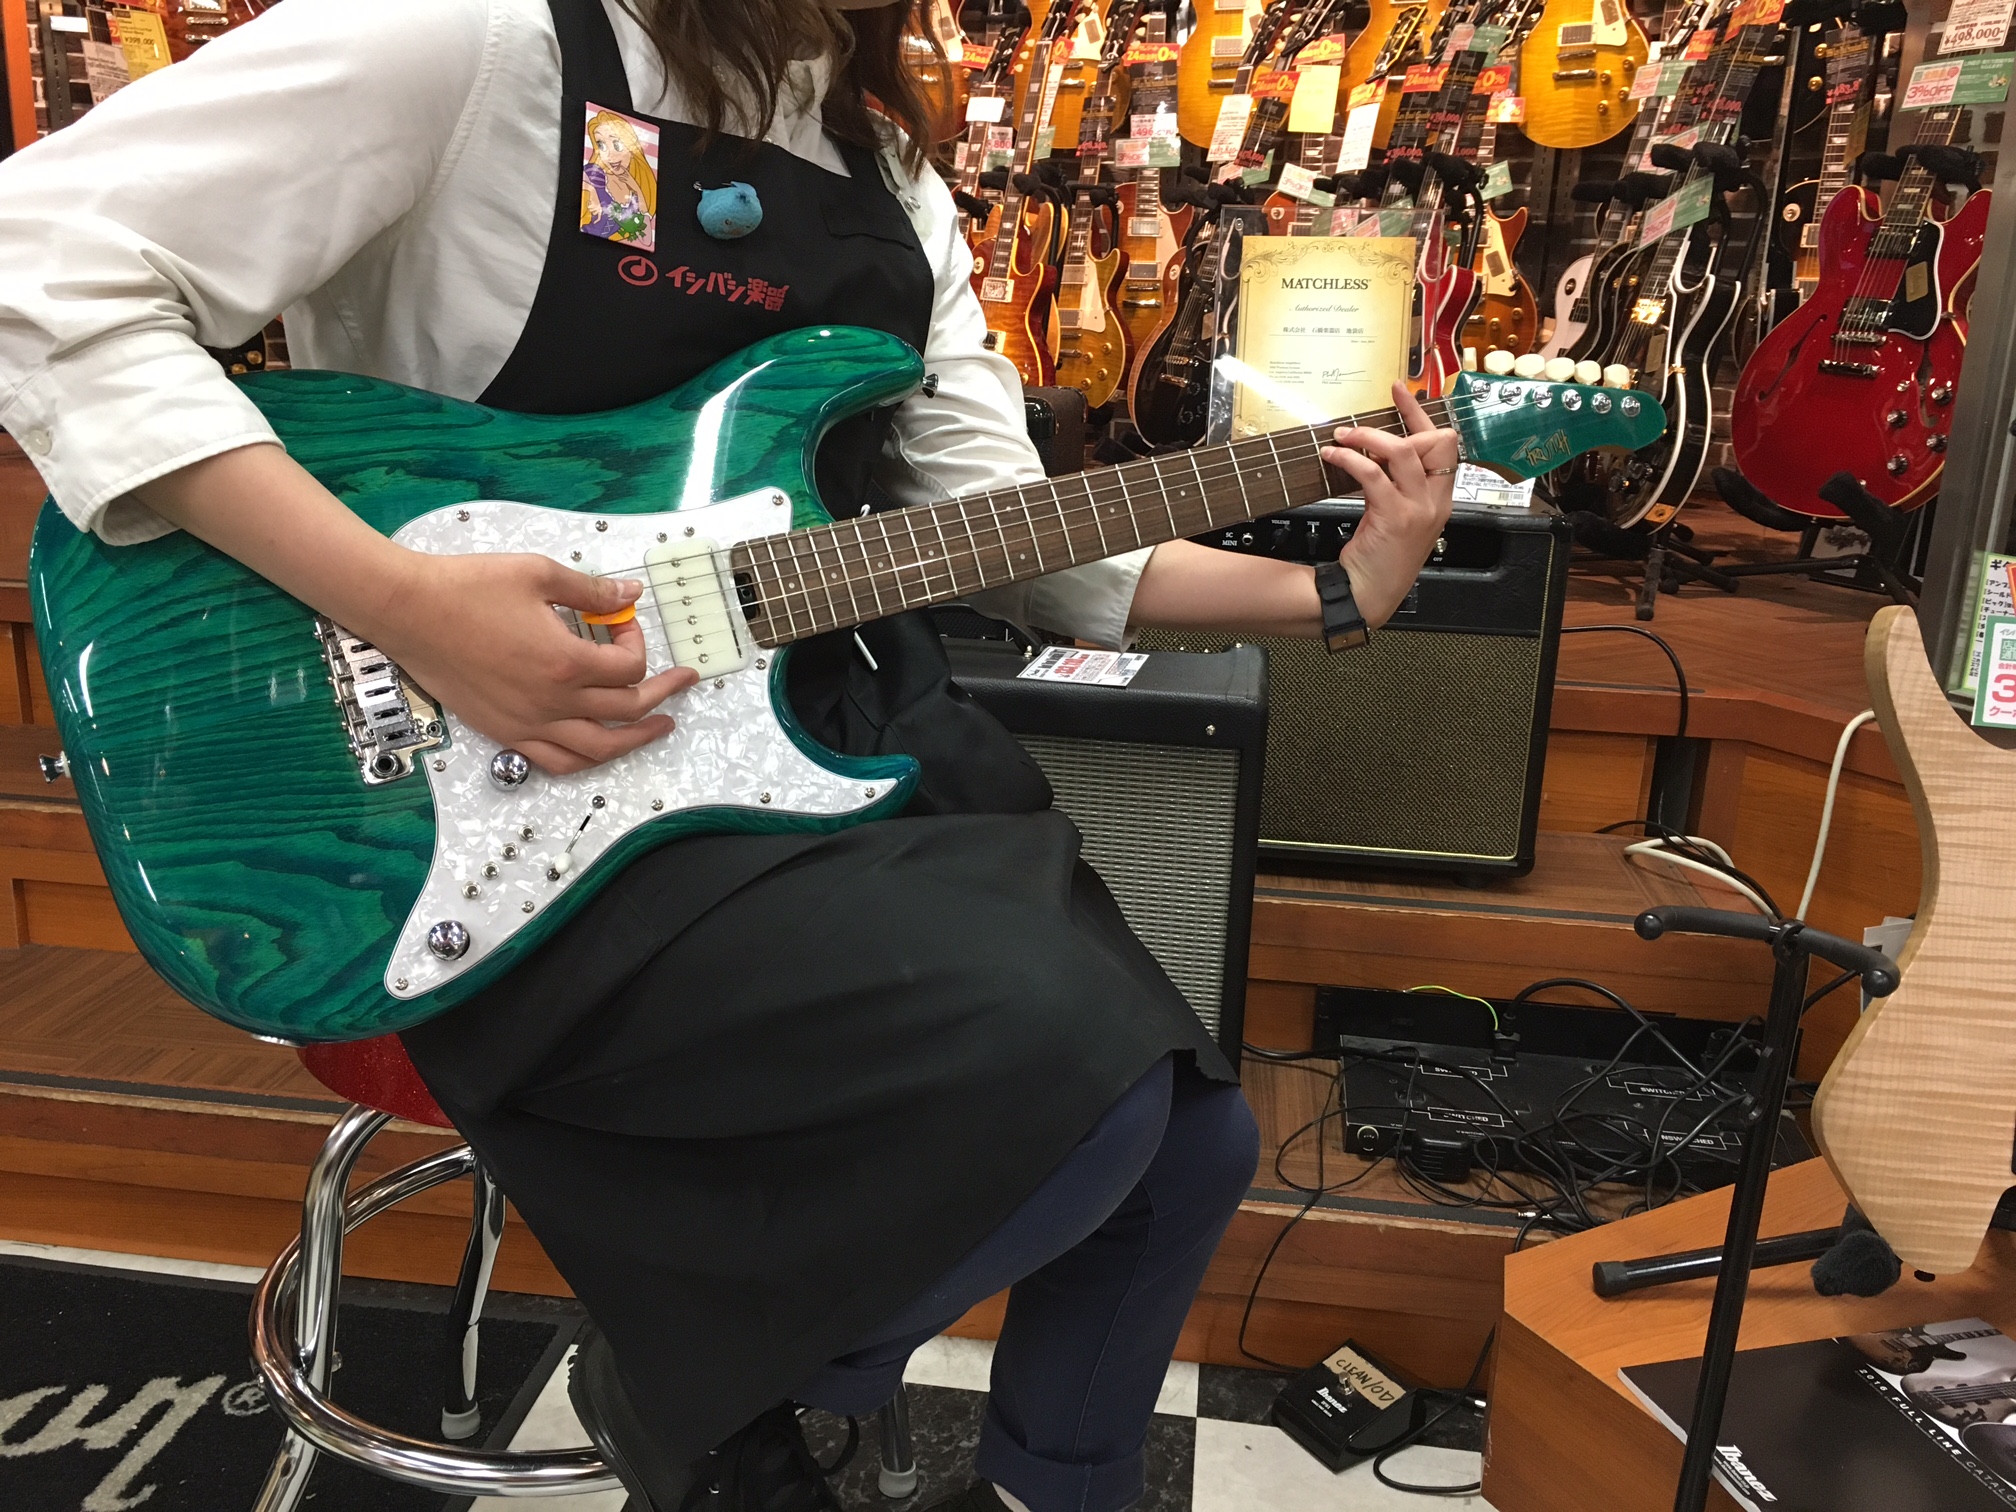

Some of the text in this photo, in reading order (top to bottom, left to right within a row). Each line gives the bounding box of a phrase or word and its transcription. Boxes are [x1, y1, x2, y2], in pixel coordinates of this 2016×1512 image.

[1907, 84, 1954, 99] 3%OFF
[665, 265, 790, 311] イシバシ楽器
[1281, 278, 1369, 290] MATCHLESS
[1289, 304, 1360, 313] Authorized Dealer
[1336, 1359, 1395, 1401] CLEAN/OD
[1316, 1386, 1348, 1413] Ibanez
[1859, 1369, 1888, 1391] 2016
[1891, 1397, 1923, 1424] FULL
[1928, 1429, 1962, 1456] LINE
[1715, 1444, 1778, 1502] Ibanez
